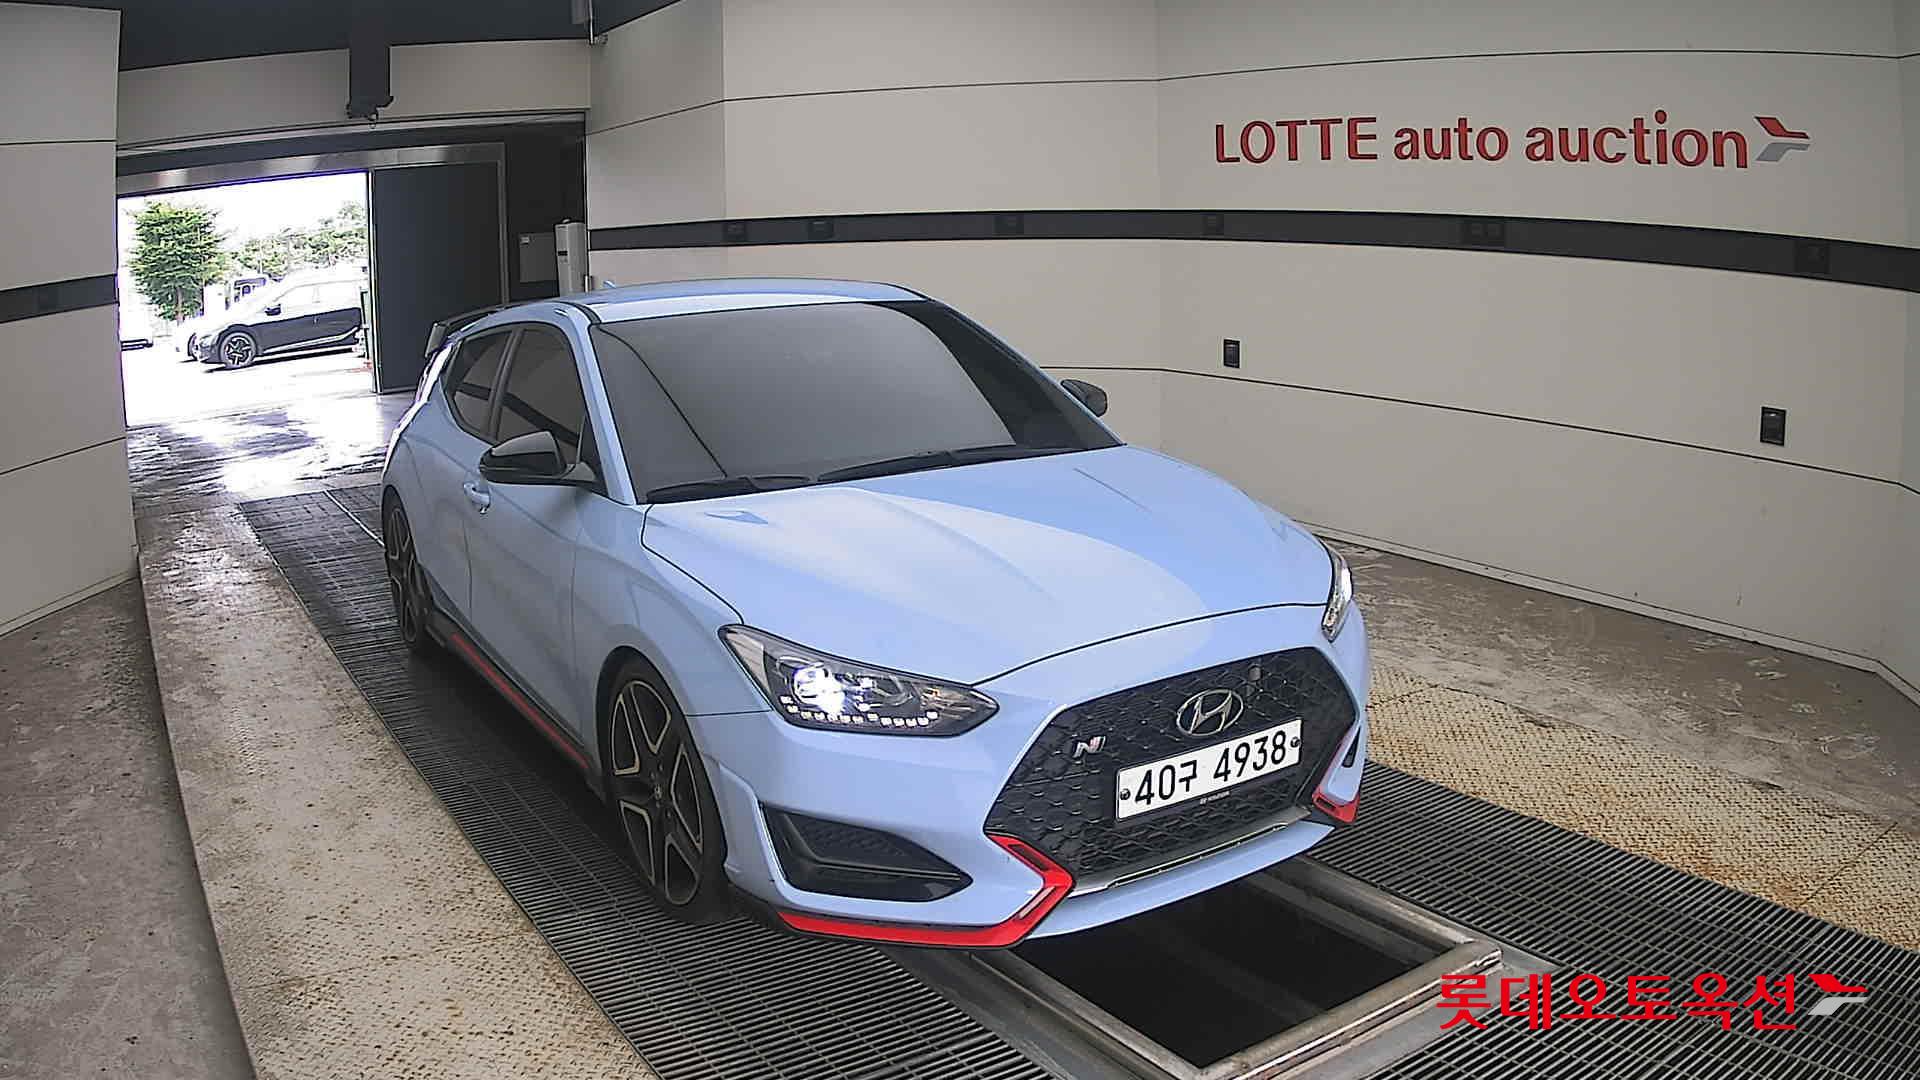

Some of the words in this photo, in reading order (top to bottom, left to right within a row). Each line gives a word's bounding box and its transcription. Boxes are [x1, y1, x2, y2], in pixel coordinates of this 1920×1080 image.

[1215, 116, 1378, 163] LOTTE
[1393, 117, 1510, 161] auto
[1523, 109, 1749, 169] auction
[1135, 759, 1198, 806] 40구
[1213, 730, 1287, 782] 4938
